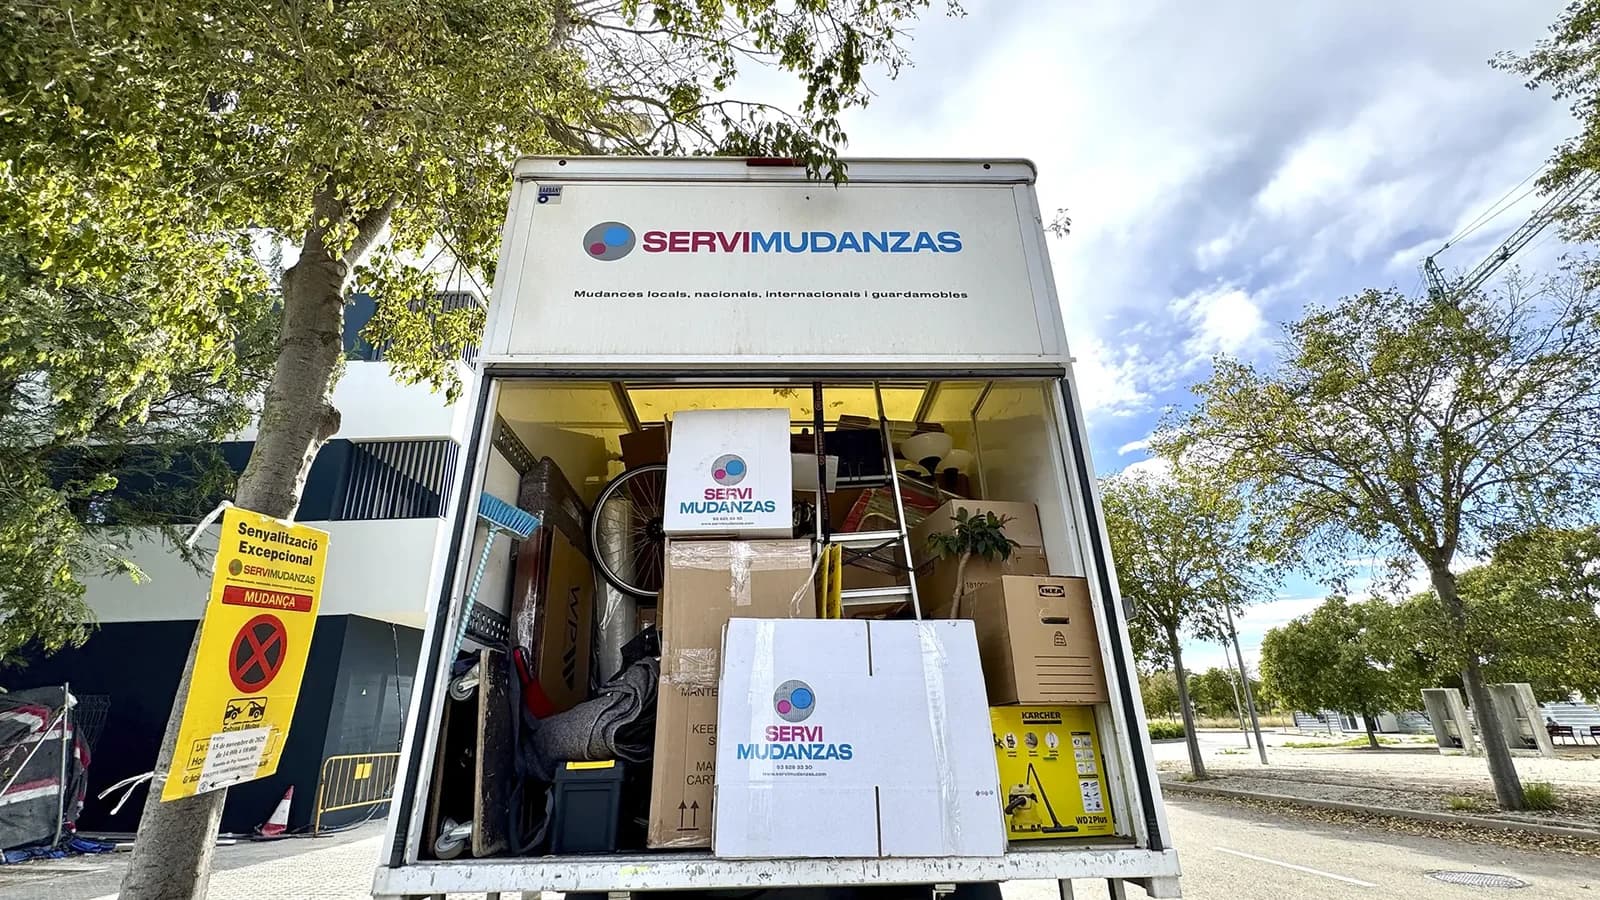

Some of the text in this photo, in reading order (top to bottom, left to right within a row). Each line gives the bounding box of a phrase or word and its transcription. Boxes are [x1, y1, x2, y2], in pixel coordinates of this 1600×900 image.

[642, 231, 962, 253] SERVIMUDANZAS
[574, 290, 643, 298] Mudances
[647, 290, 691, 299] locals,
[694, 290, 762, 299] nacionals,
[766, 290, 861, 298] internacionals
[872, 290, 968, 299] guardamobles
[704, 488, 752, 500] SERVI
[680, 501, 776, 514] MUDANZAS
[238, 522, 318, 551] Senyalització
[238, 540, 313, 566] Excepcional
[243, 564, 316, 584] SERVIMUDANZAS
[244, 590, 296, 609] MUDANÇA
[765, 726, 823, 742] SERVI
[737, 743, 853, 760] MUDANZAS
